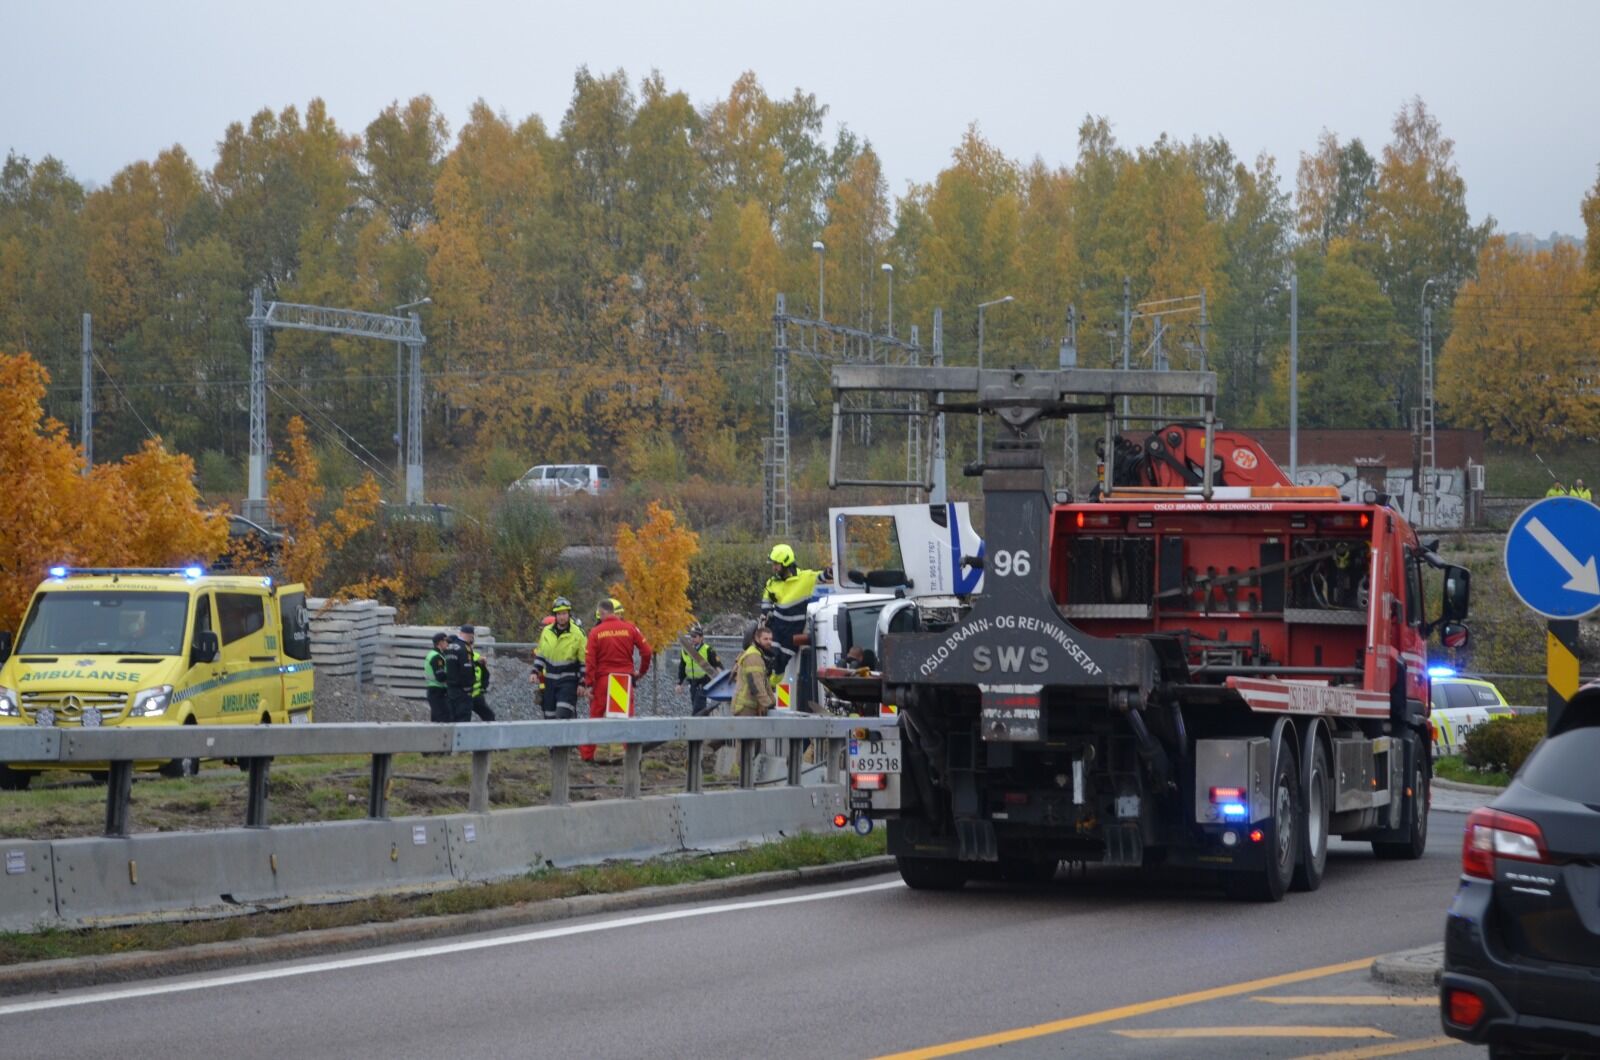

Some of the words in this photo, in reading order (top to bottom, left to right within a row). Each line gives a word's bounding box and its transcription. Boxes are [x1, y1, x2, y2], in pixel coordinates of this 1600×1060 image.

[1235, 451, 1255, 467] PM
[1153, 503, 1174, 511] OSLO
[1206, 503, 1217, 511] OG
[1220, 503, 1273, 511] REDNINGSETAT
[994, 549, 1030, 577] 96
[920, 646, 949, 676] OSLO
[996, 615, 1015, 629] OG
[972, 645, 1049, 673] SWS
[19, 670, 141, 682] AMBULANSE
[222, 693, 259, 712] AMBULANSE
[870, 741, 887, 755] DL
[858, 758, 899, 771] 89518
